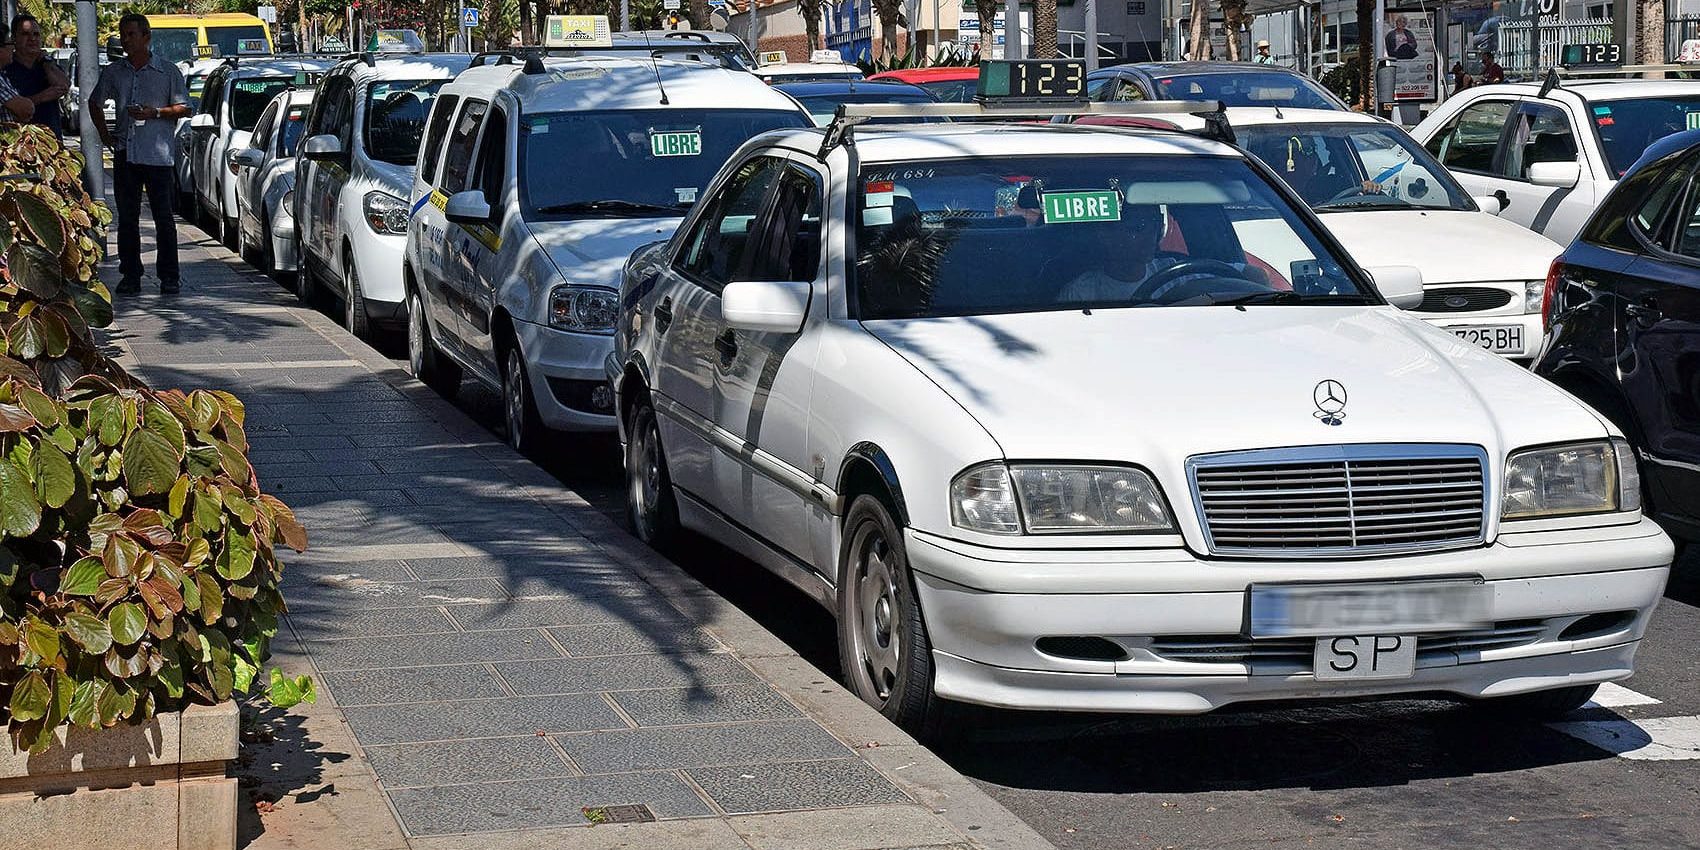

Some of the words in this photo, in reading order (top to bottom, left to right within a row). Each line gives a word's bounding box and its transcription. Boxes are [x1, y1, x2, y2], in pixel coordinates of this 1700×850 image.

[568, 19, 590, 27] TAXI
[198, 46, 213, 55] TAXI
[246, 41, 263, 50] TAXI
[1585, 44, 1620, 62] 123
[1016, 63, 1083, 95] 123
[653, 134, 700, 156] LIBRE
[903, 168, 936, 180] 684
[1053, 196, 1110, 219] LIBRE
